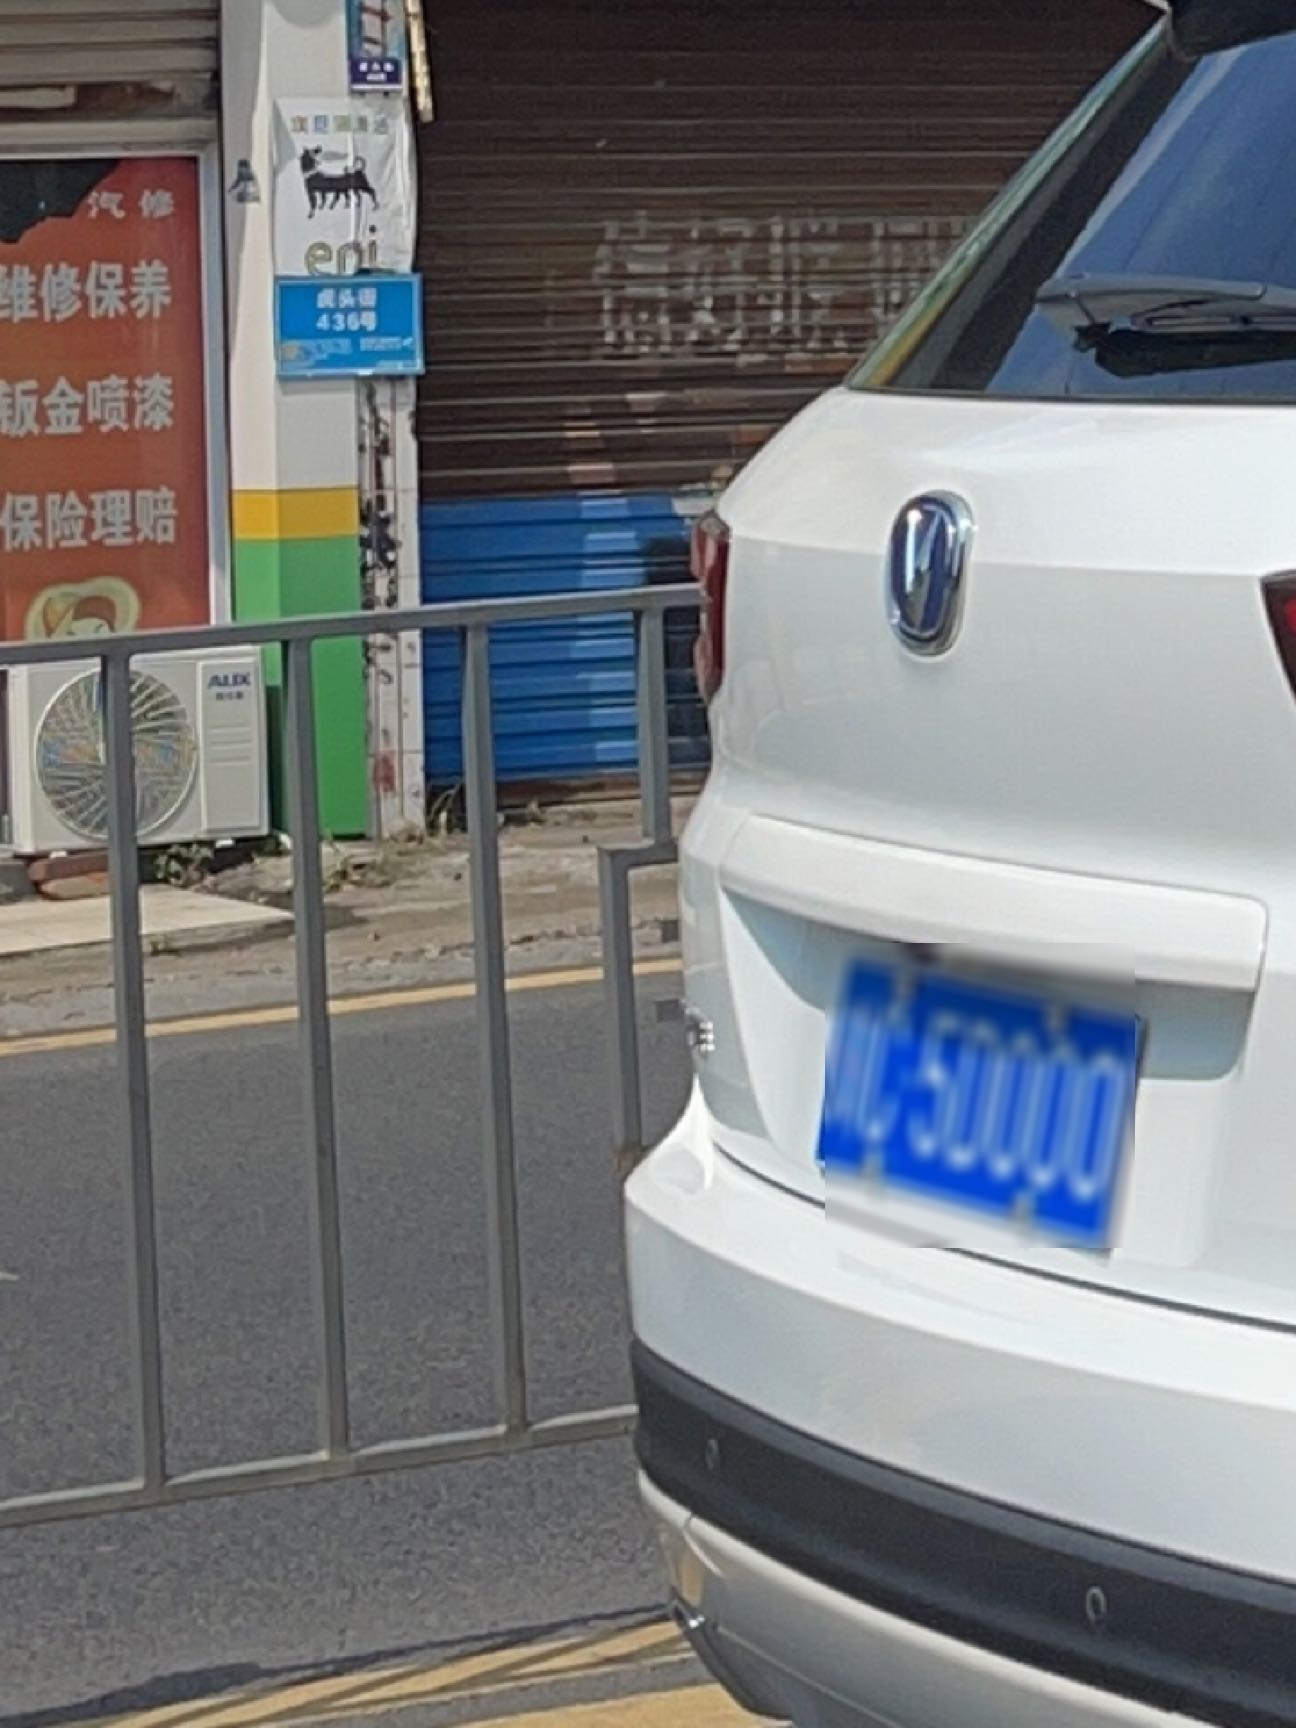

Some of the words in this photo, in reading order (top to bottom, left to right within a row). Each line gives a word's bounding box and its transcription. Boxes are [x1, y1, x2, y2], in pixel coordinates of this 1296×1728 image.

[0, 260, 171, 322] 维修保养
[0, 373, 174, 437] 钣金喷漆
[0, 486, 178, 552] 保险理赔
